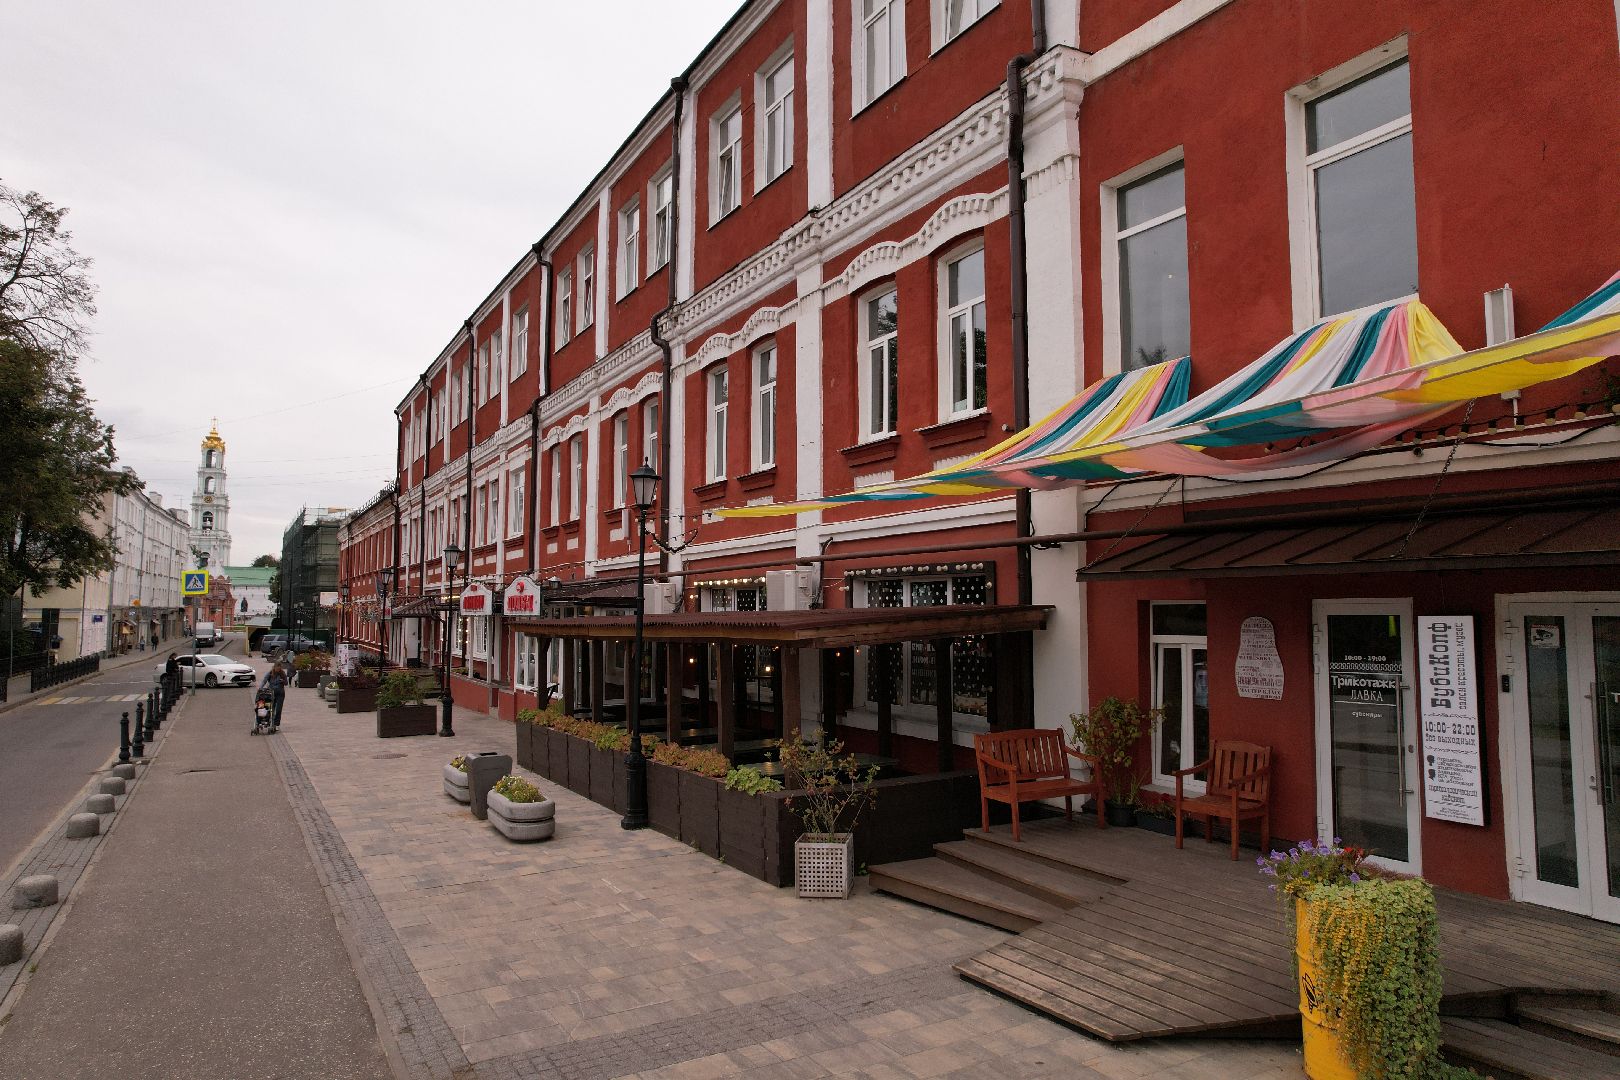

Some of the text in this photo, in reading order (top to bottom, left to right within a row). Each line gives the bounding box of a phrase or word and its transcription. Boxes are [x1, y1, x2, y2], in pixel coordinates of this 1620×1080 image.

[1427, 622, 1455, 709] БубиКопф
[1331, 675, 1396, 689] Трикотажк
[1350, 689, 1384, 702] ЛАВКА
[1437, 735, 1476, 746] выходных
